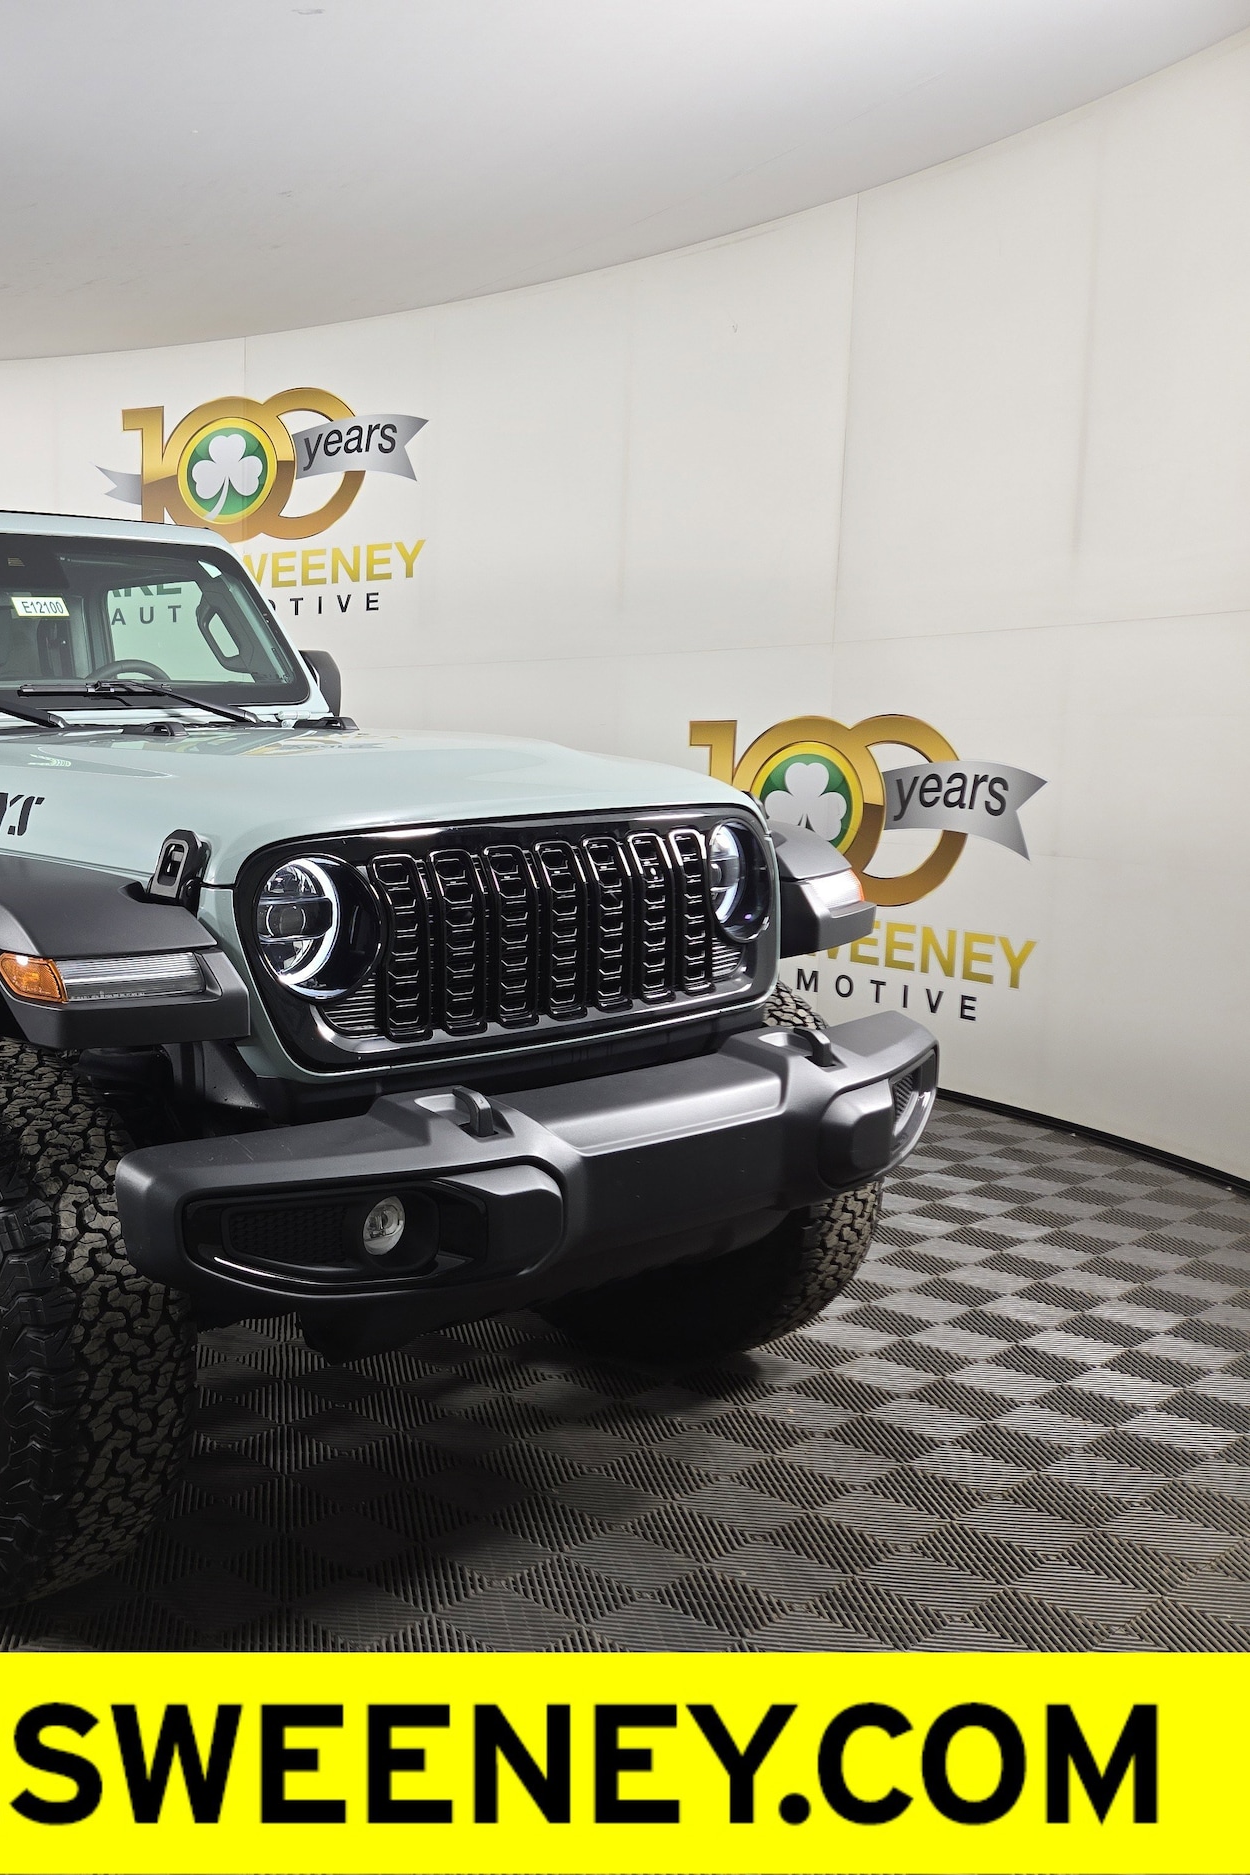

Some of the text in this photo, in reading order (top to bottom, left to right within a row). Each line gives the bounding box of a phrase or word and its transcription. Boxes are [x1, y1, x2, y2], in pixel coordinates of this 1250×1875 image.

[121, 387, 399, 544] 100 years
[242, 539, 427, 589] EENEY
[21, 601, 64, 614] E12100
[892, 771, 1010, 822] years
[806, 919, 1038, 990] EENEY
[795, 967, 979, 1022] MOTIVE
